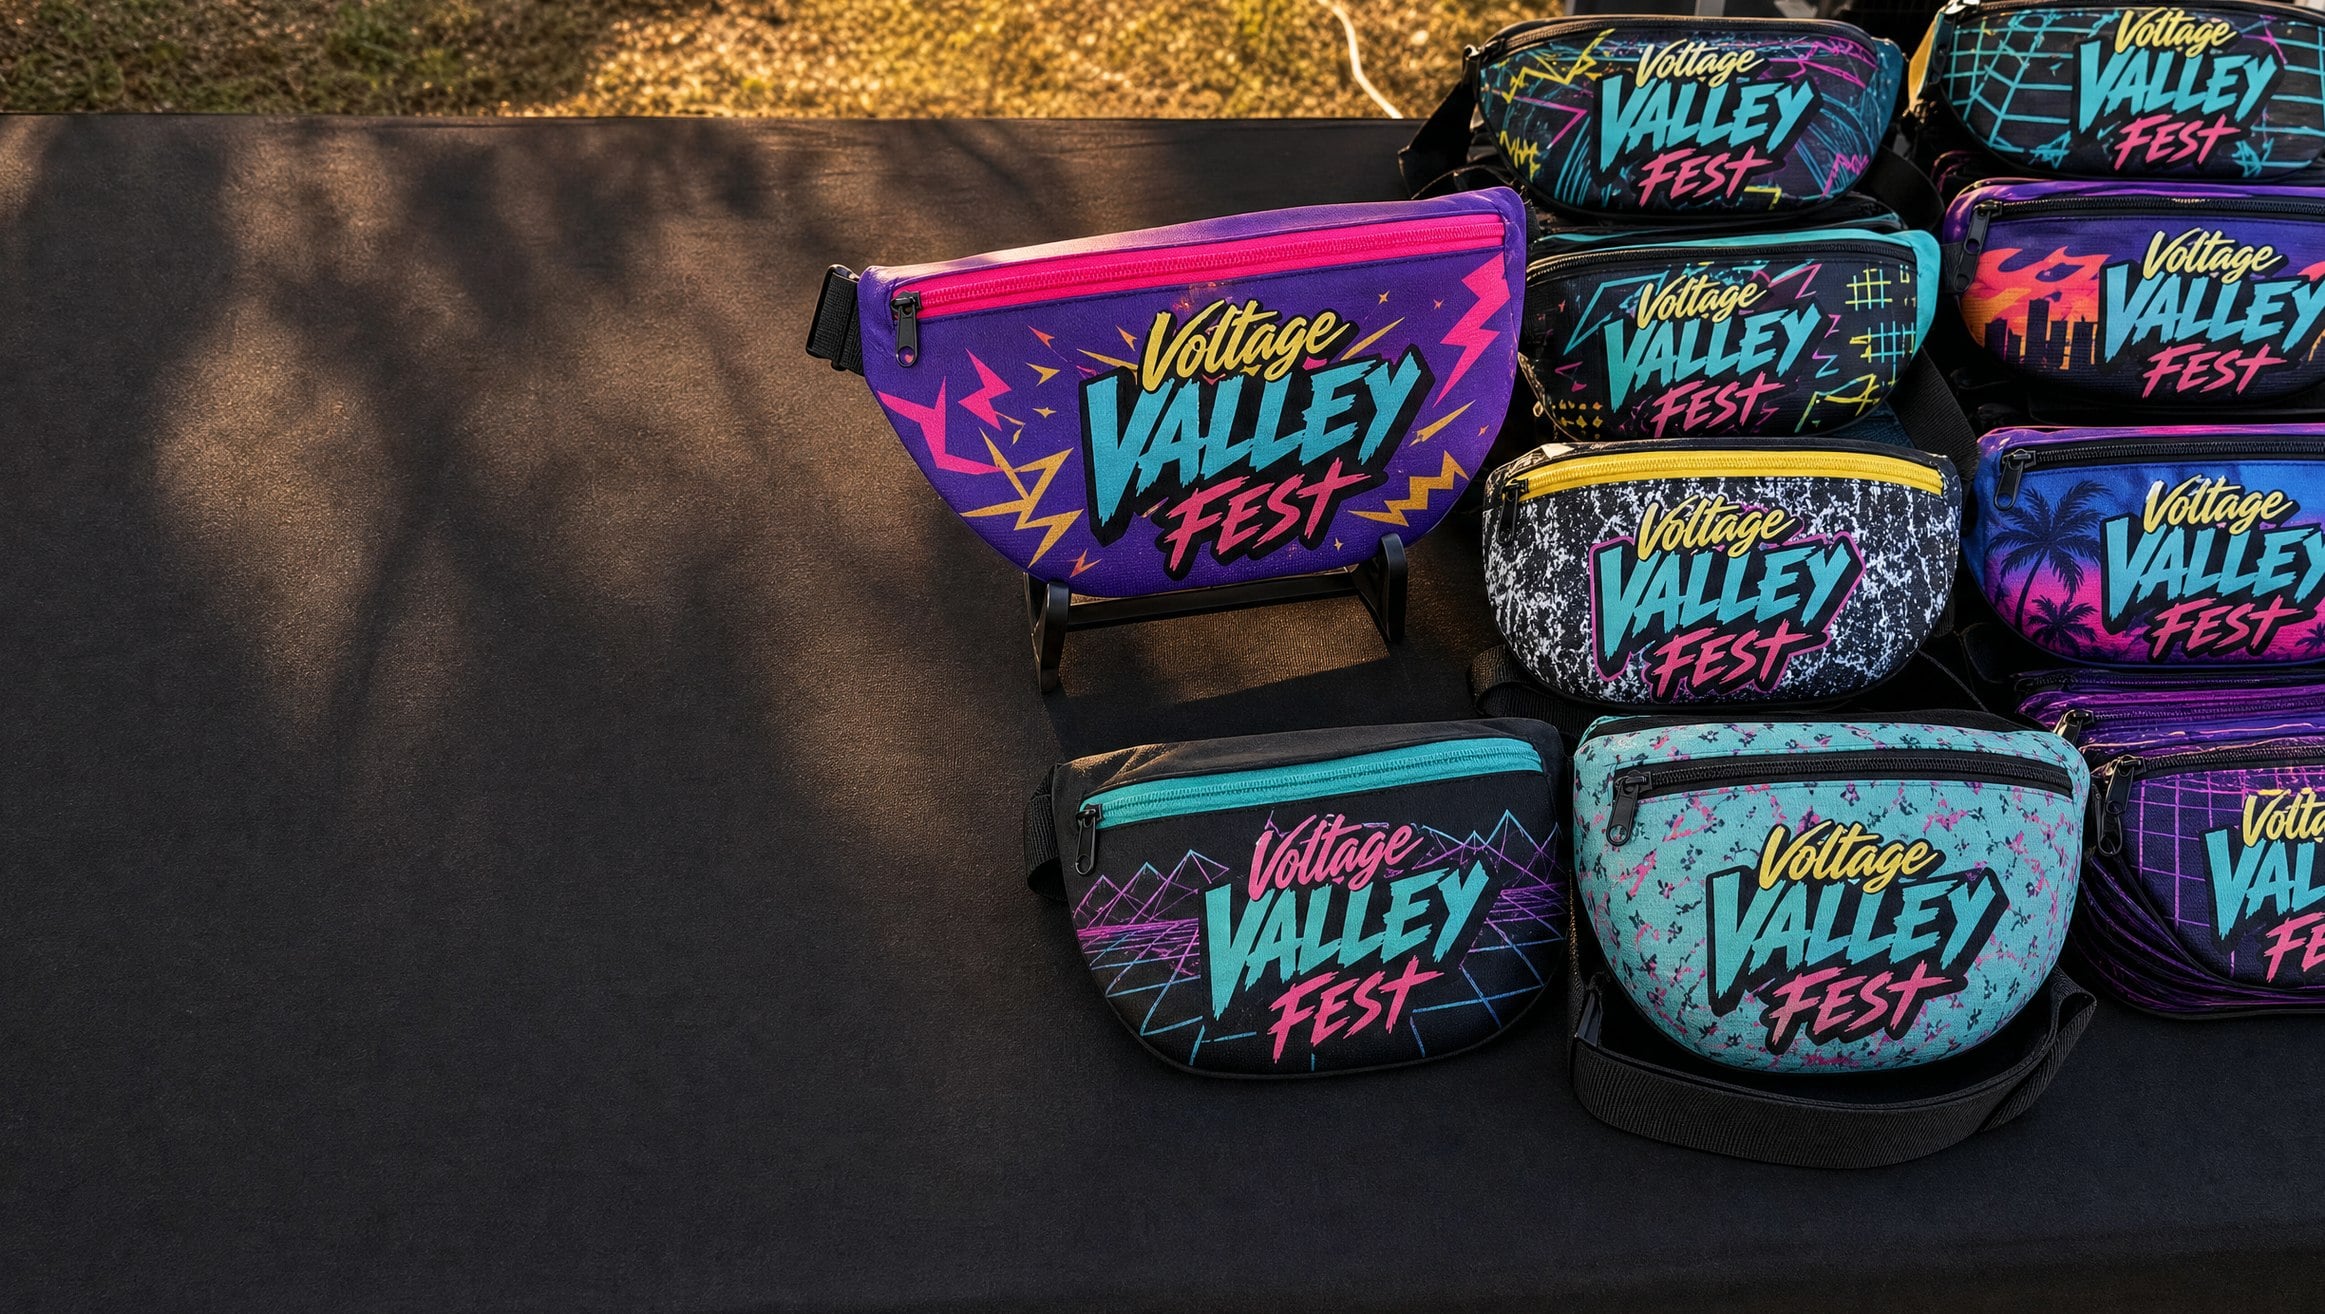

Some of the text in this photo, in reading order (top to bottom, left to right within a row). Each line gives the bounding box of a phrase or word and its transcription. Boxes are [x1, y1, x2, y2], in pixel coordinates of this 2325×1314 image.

[1636, 39, 1765, 87] Voltage
[2115, 7, 2237, 57] Voltage
[1600, 75, 1814, 172] VALLEY
[2079, 41, 2277, 134] VALLEY
[1638, 145, 1773, 207] FEST
[2114, 114, 2241, 170] FEST
[2143, 228, 2282, 284] Voltage
[1637, 274, 1766, 329] Voltage
[2105, 264, 2325, 363] VALLEY
[1141, 300, 1351, 391] Voltage
[1604, 303, 1822, 413] VALLEY
[2142, 343, 2287, 398] FEST
[1087, 352, 1420, 523] VALLEY
[1651, 371, 1786, 438] FEST
[1164, 458, 1370, 571] FEST
[1638, 495, 1796, 560] Voltage
[2143, 474, 2293, 535] Voltage
[1600, 542, 1851, 661] VALLEY
[2151, 595, 2303, 659] FEST
[1652, 619, 1813, 697] FEST
[1250, 814, 1423, 900] Voltage
[1758, 821, 1938, 893] Voltage
[1205, 861, 1489, 1020] VALLEY
[1713, 872, 1996, 998] VALLEY
[1268, 957, 1444, 1063] FEST
[1769, 960, 1952, 1044] FEST
